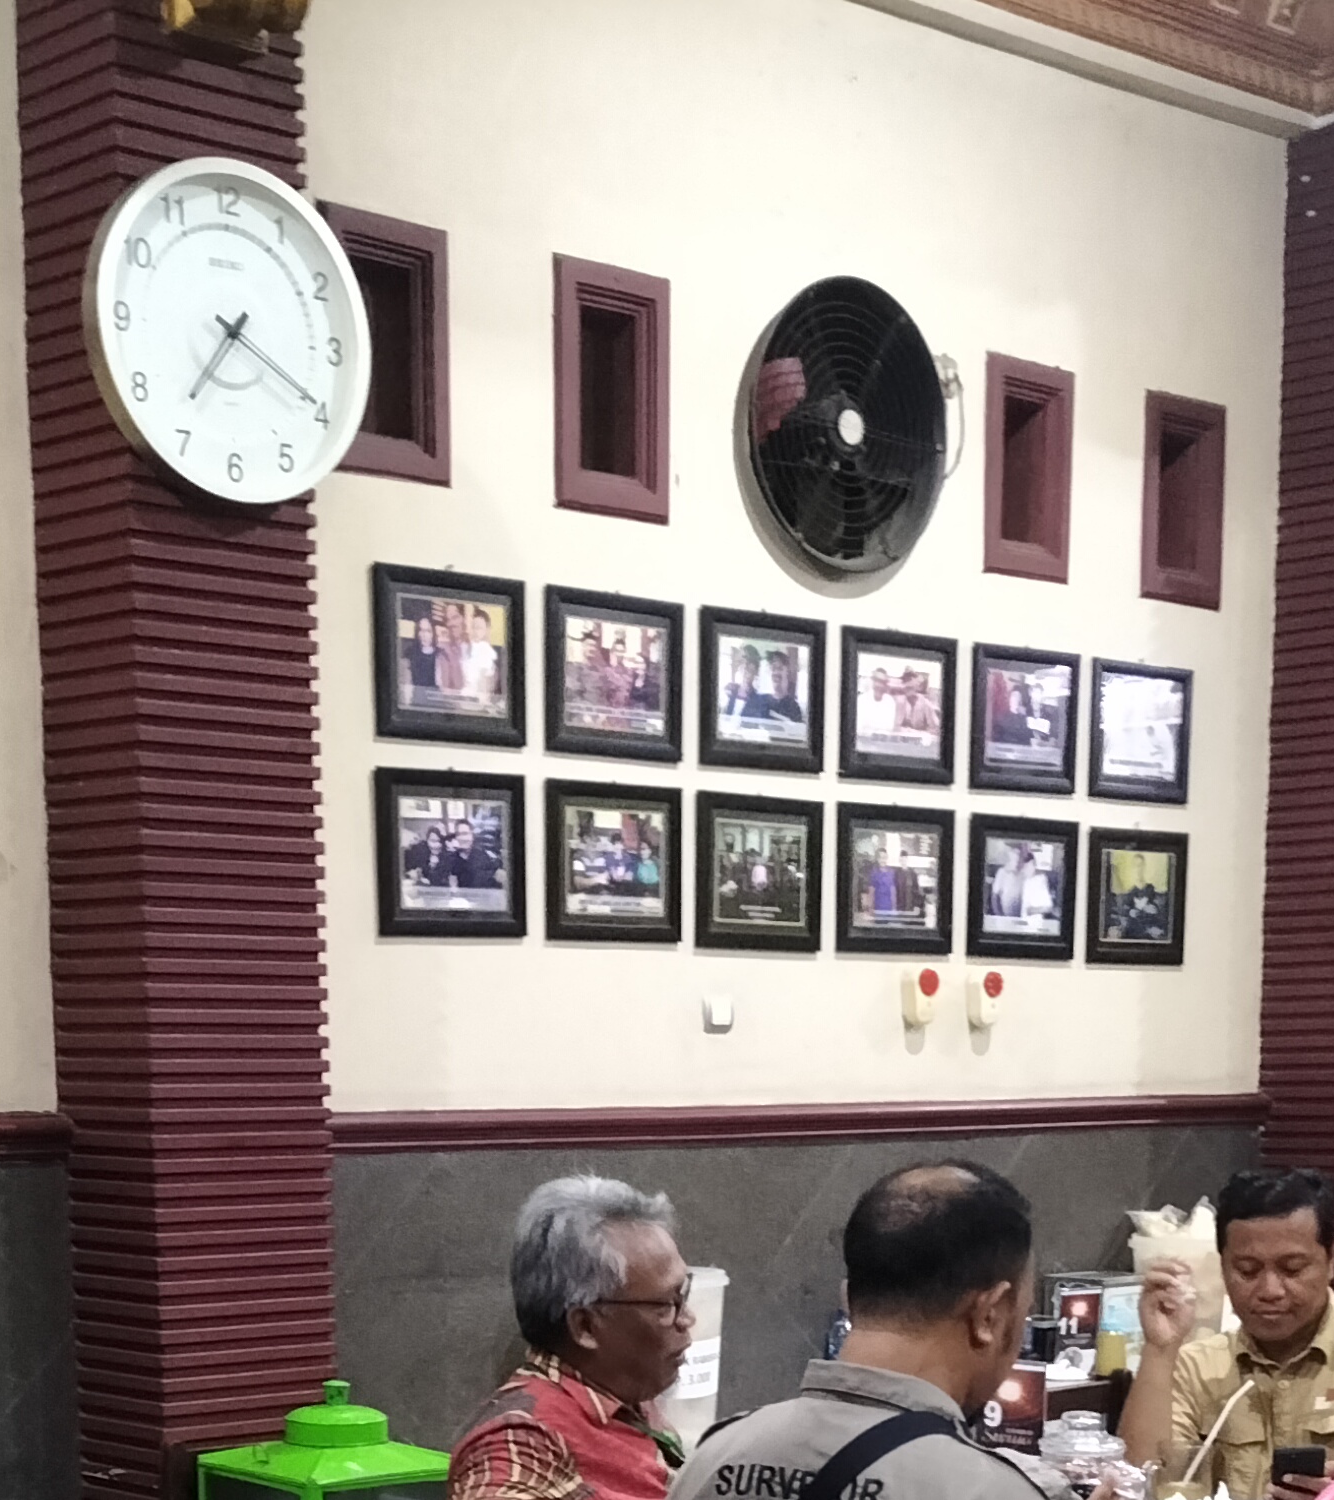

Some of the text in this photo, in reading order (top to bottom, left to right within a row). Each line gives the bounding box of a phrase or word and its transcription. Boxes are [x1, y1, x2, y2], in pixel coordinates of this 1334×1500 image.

[160, 193, 186, 226] 11
[214, 186, 241, 217] 12
[274, 215, 285, 244] 1
[124, 235, 152, 269] 10
[313, 271, 329, 302] 2
[113, 300, 130, 331] 9
[327, 337, 343, 367] 3
[130, 371, 148, 403] 8
[314, 400, 330, 429] 4
[175, 429, 192, 456] 7
[227, 453, 243, 482] 6
[279, 444, 295, 473] 5
[1057, 1316, 1078, 1335] 11
[983, 1400, 1003, 1428] 9
